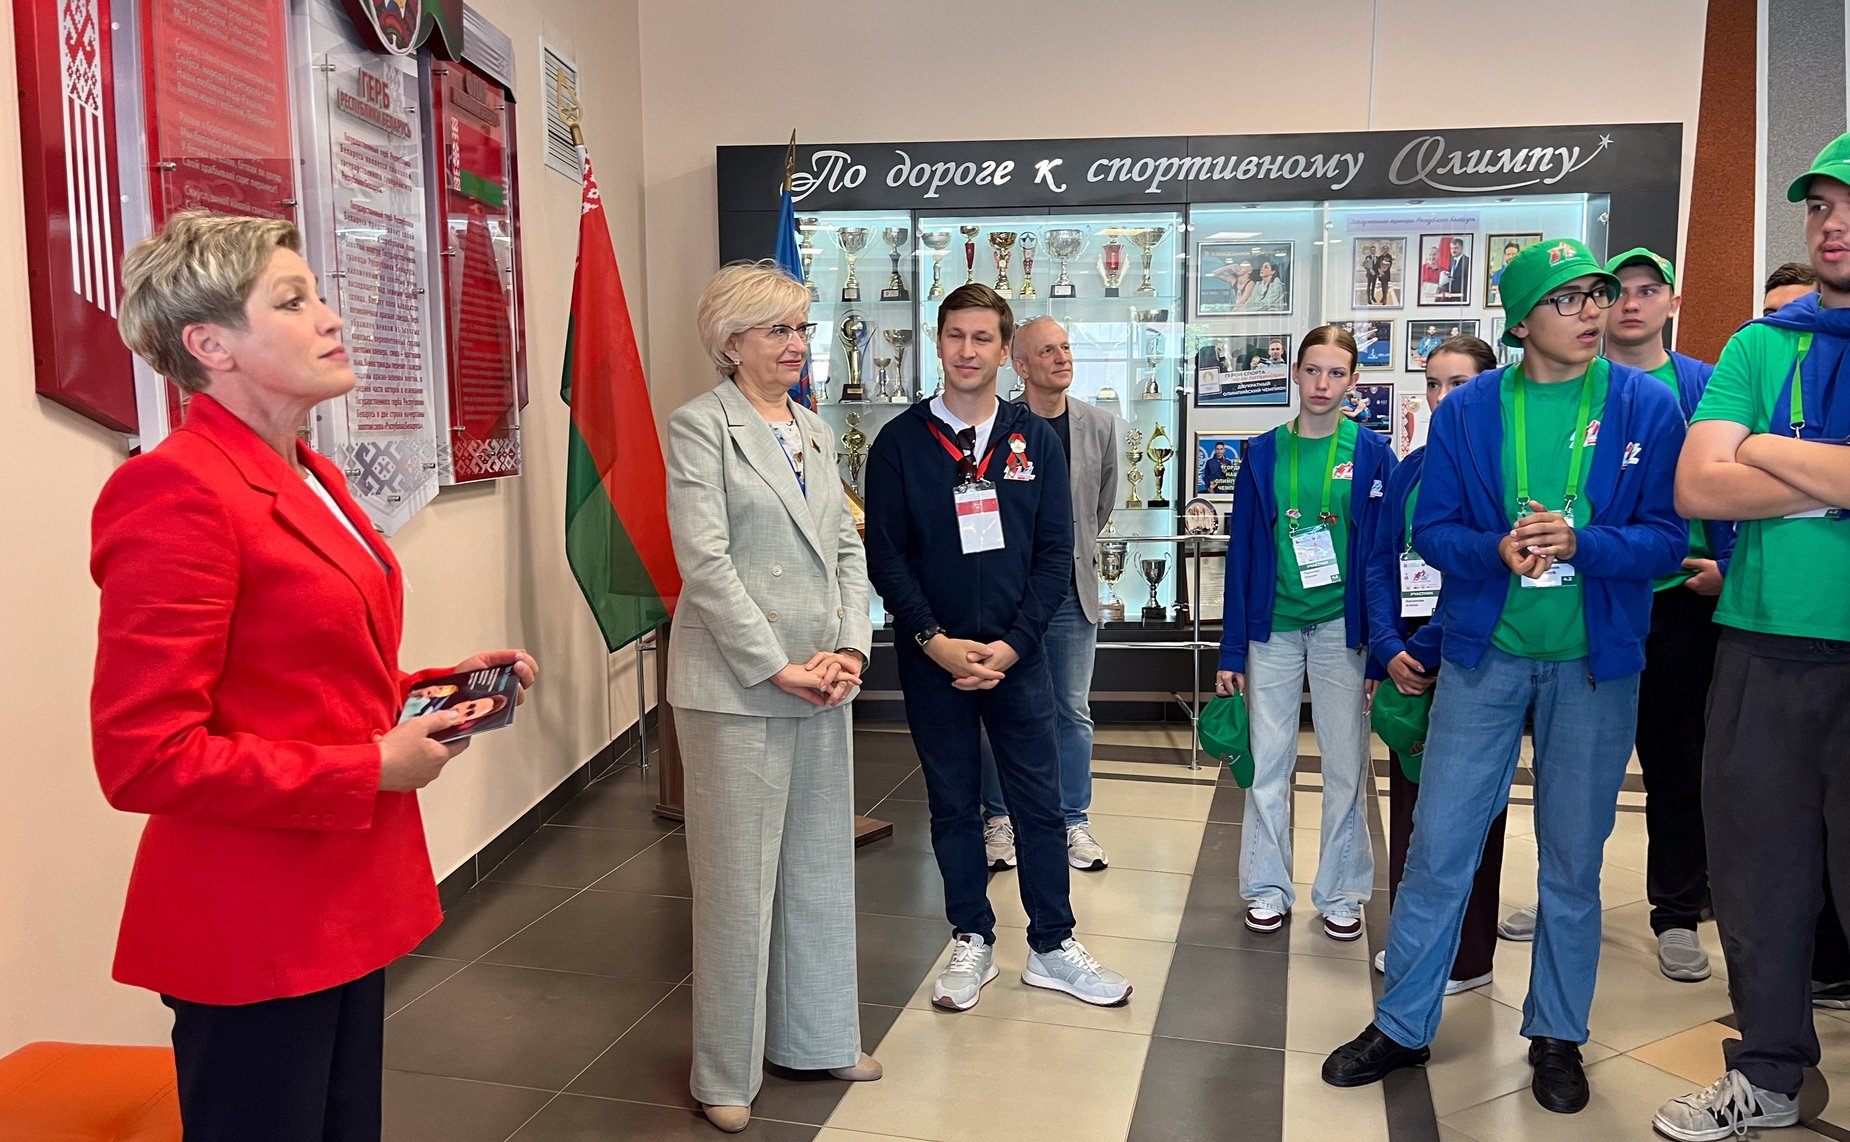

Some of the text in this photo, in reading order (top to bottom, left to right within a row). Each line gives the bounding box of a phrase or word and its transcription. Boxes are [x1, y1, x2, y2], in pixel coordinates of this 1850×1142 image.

[360, 69, 390, 110] ГЕРБ
[780, 135, 1582, 203] По дороге к спортивному Олимпу
[1243, 369, 1266, 377] СПОРТА
[1222, 387, 1261, 397] ОЛИМПИЙСКИЙ
